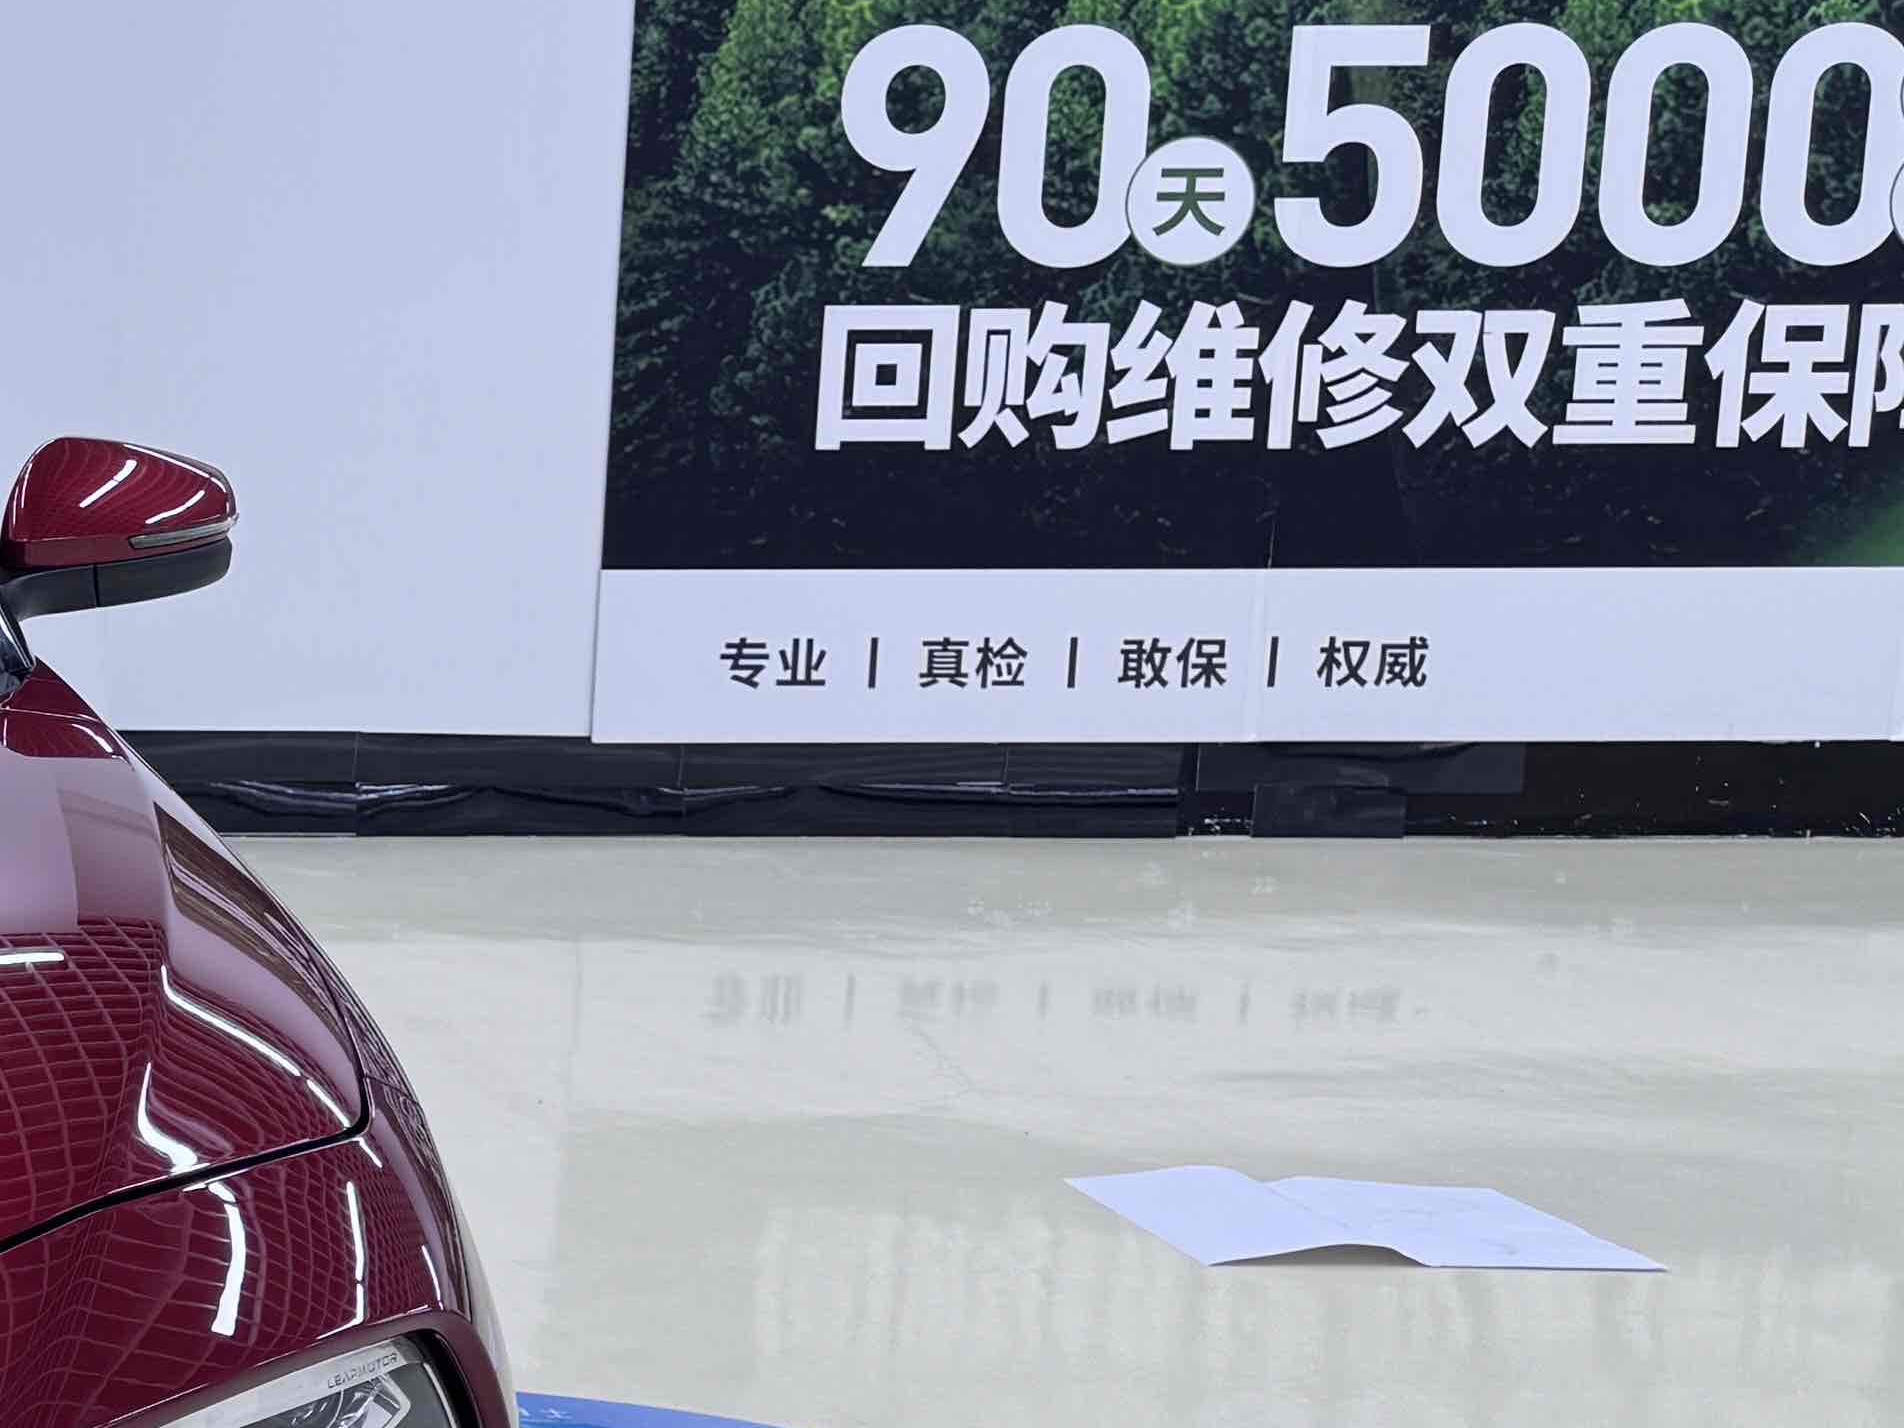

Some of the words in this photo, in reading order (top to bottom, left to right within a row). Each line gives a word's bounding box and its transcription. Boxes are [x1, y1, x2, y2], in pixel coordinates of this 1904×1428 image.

[719, 635, 828, 690] 专业
[918, 635, 1029, 690] 真检
[1116, 635, 1229, 690] 敢保
[1316, 635, 1430, 690] 权威
